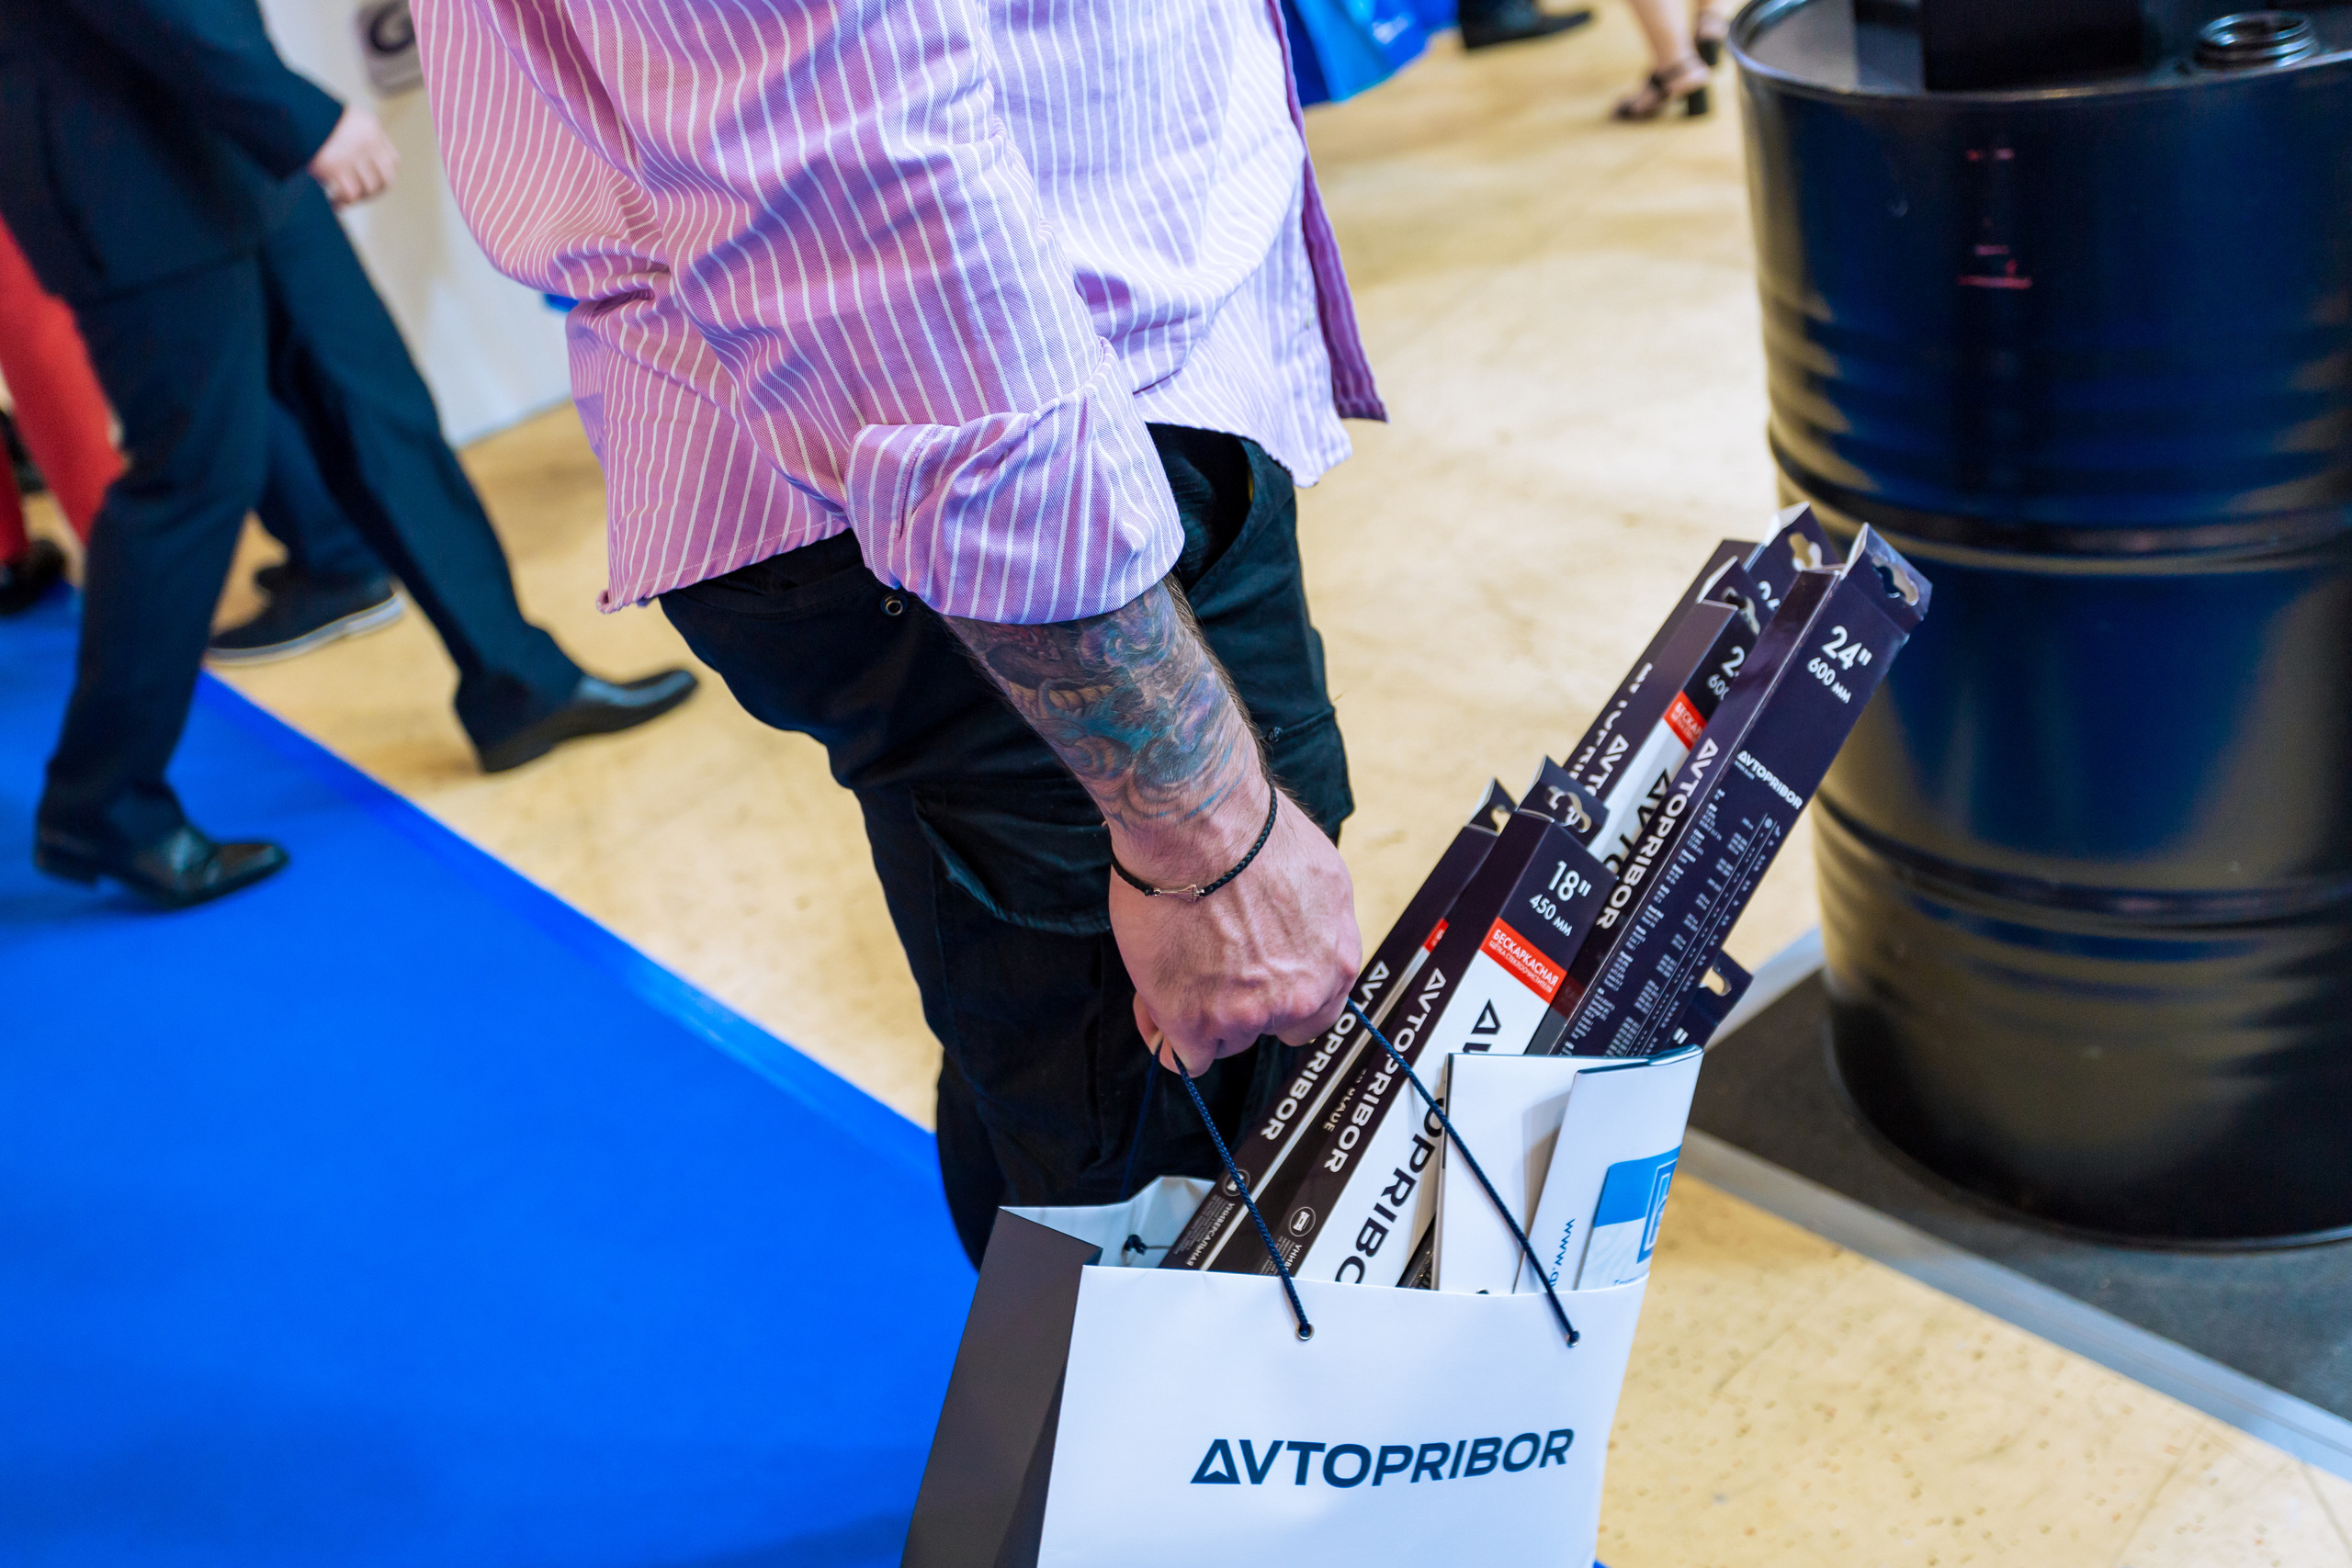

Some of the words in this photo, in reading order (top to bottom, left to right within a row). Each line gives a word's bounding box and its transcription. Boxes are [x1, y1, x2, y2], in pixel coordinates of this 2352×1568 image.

[1807, 657, 1836, 686] 600
[1823, 626, 1871, 671] 24"
[1736, 750, 1804, 810] AVTOPRIBOR
[1594, 738, 1719, 930] AVTOPRIBOR
[1529, 893, 1556, 921] 450
[1547, 860, 1592, 902] 18"
[1492, 928, 1560, 987] БЕСКАРКАСНАЯ
[1189, 1428, 1576, 1489] AVTOPRIBOR
